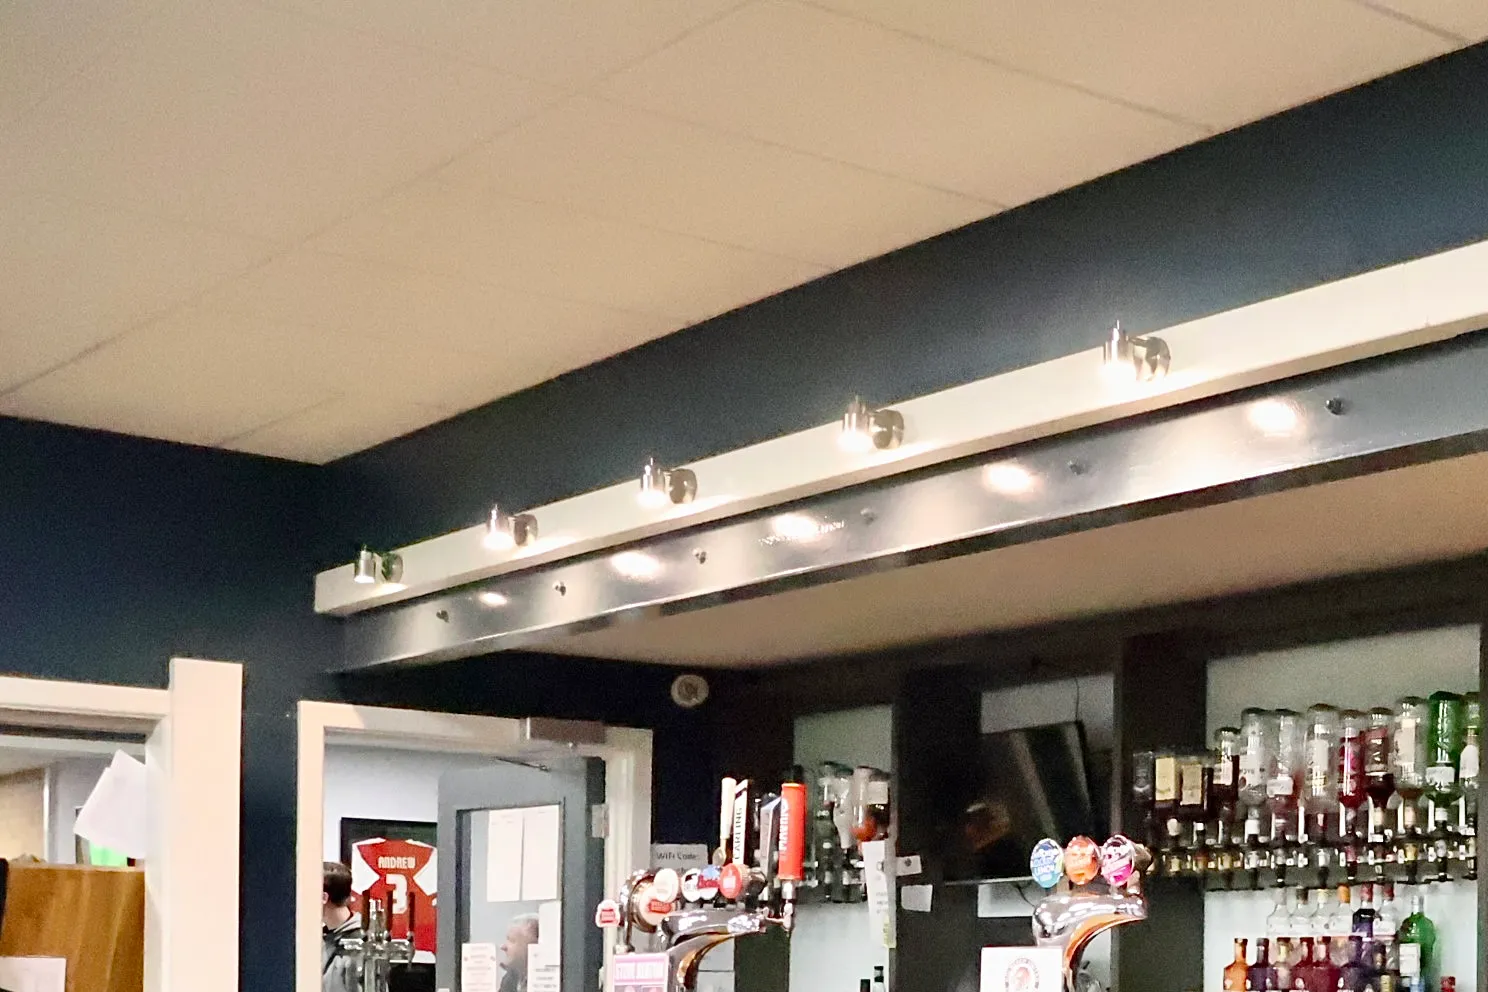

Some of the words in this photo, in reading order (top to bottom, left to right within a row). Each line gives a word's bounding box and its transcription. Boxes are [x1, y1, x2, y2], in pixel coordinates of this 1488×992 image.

[733, 807, 743, 860] CARLING
[377, 856, 416, 869] ANDREW
[386, 873, 408, 915] 3
